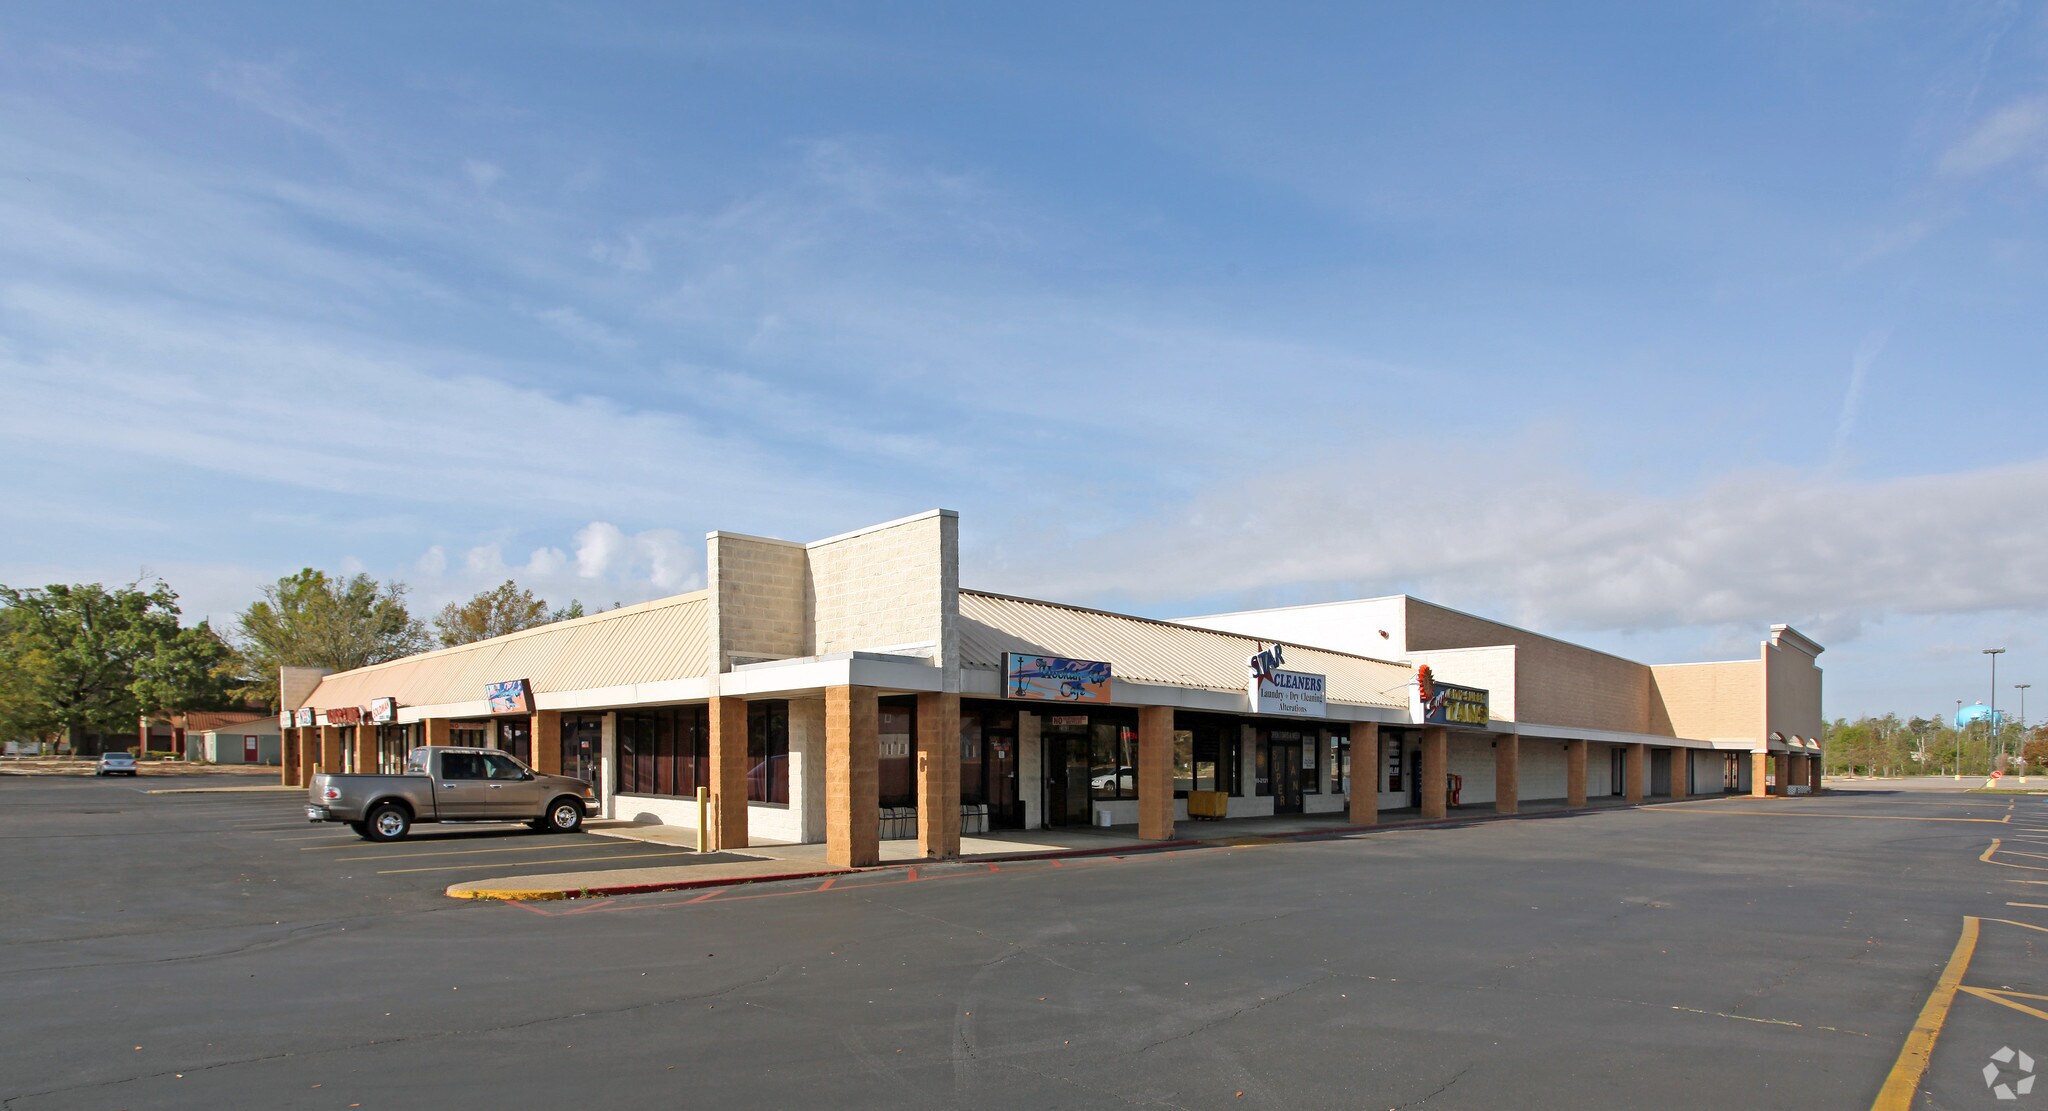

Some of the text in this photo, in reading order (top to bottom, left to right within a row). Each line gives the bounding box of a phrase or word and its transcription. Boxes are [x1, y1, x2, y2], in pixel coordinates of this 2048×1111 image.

[1250, 644, 1285, 678] STAR
[1274, 673, 1322, 691] CLEANERS
[1261, 688, 1323, 703] Laundry Dry Cleaning
[1279, 703, 1308, 712] Alterations
[1443, 701, 1488, 725] TANS
[1053, 716, 1063, 725] NO
[1272, 750, 1286, 806] SUPER
[1288, 750, 1301, 806] TANS
